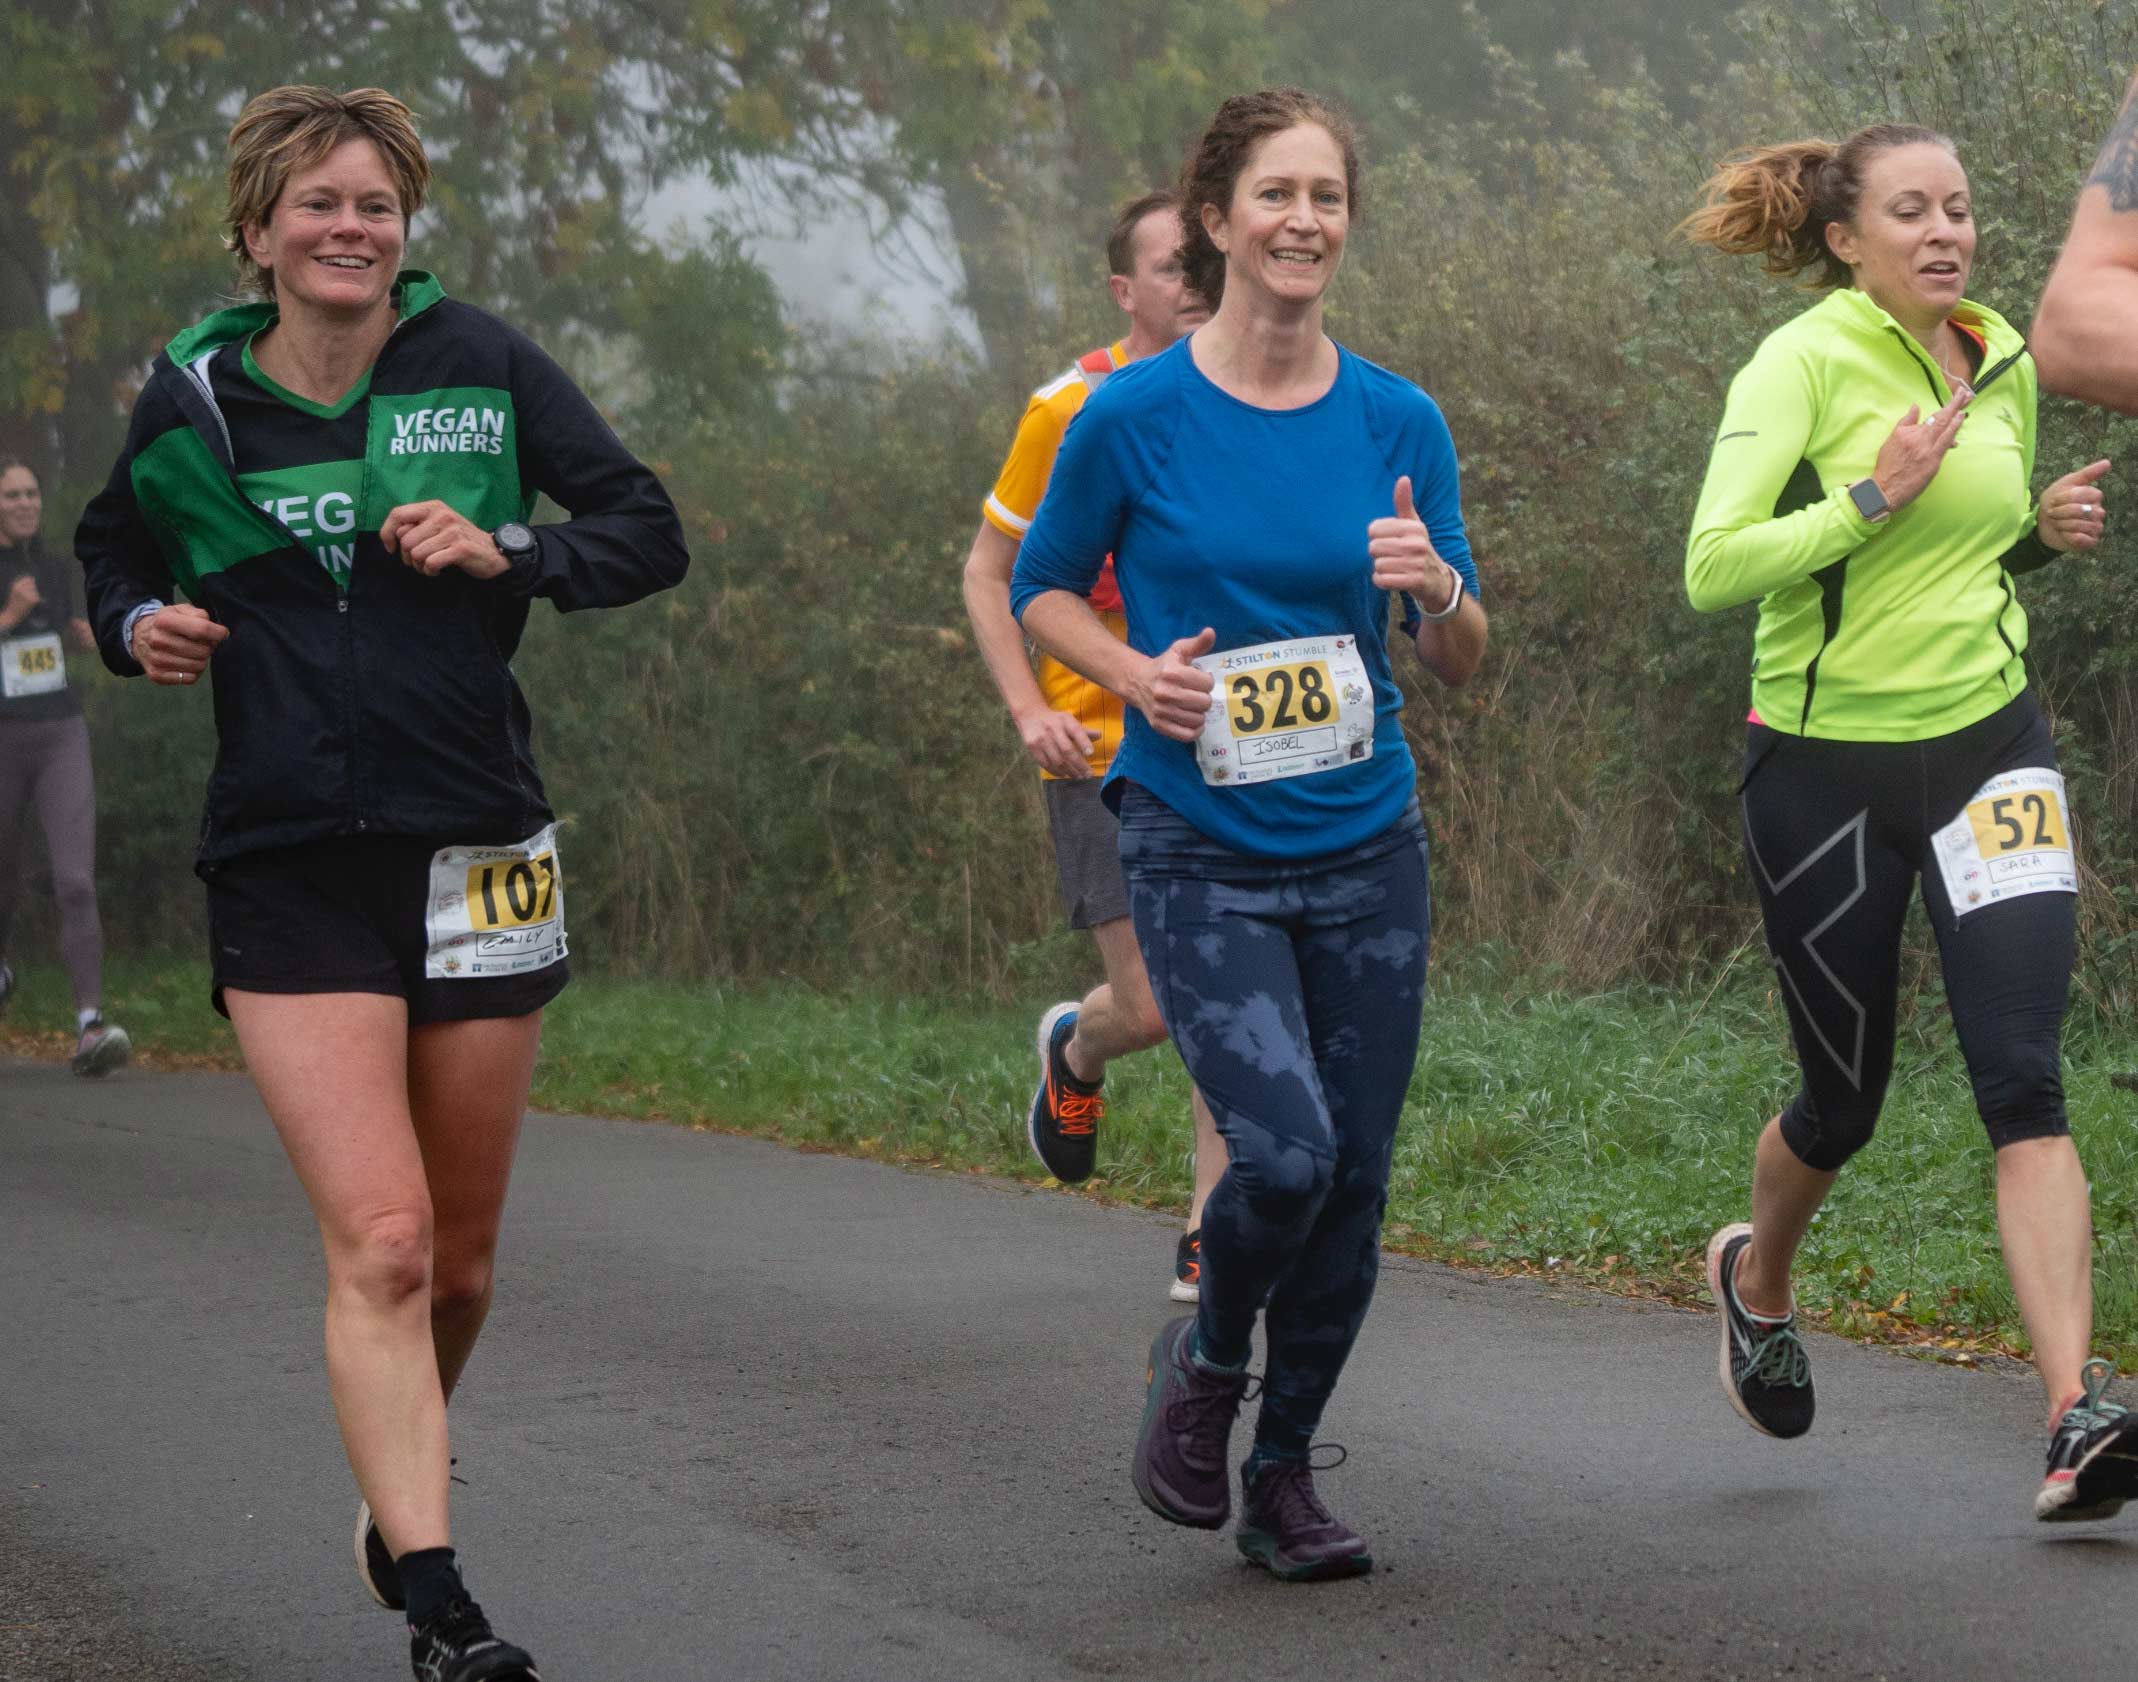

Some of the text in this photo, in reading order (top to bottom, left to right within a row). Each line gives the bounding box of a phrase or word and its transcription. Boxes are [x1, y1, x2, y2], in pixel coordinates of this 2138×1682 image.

[394, 407, 505, 438] VEGAN
[390, 433, 503, 455] RUNNERS
[1235, 644, 1328, 667] STILTON STUMBLE
[1232, 665, 1332, 734] 328
[1253, 735, 1305, 757] ISOBEL
[1992, 793, 2055, 850] 52
[1999, 855, 2043, 874] SARA
[481, 854, 555, 926] 107
[482, 928, 544, 950] EMILY
